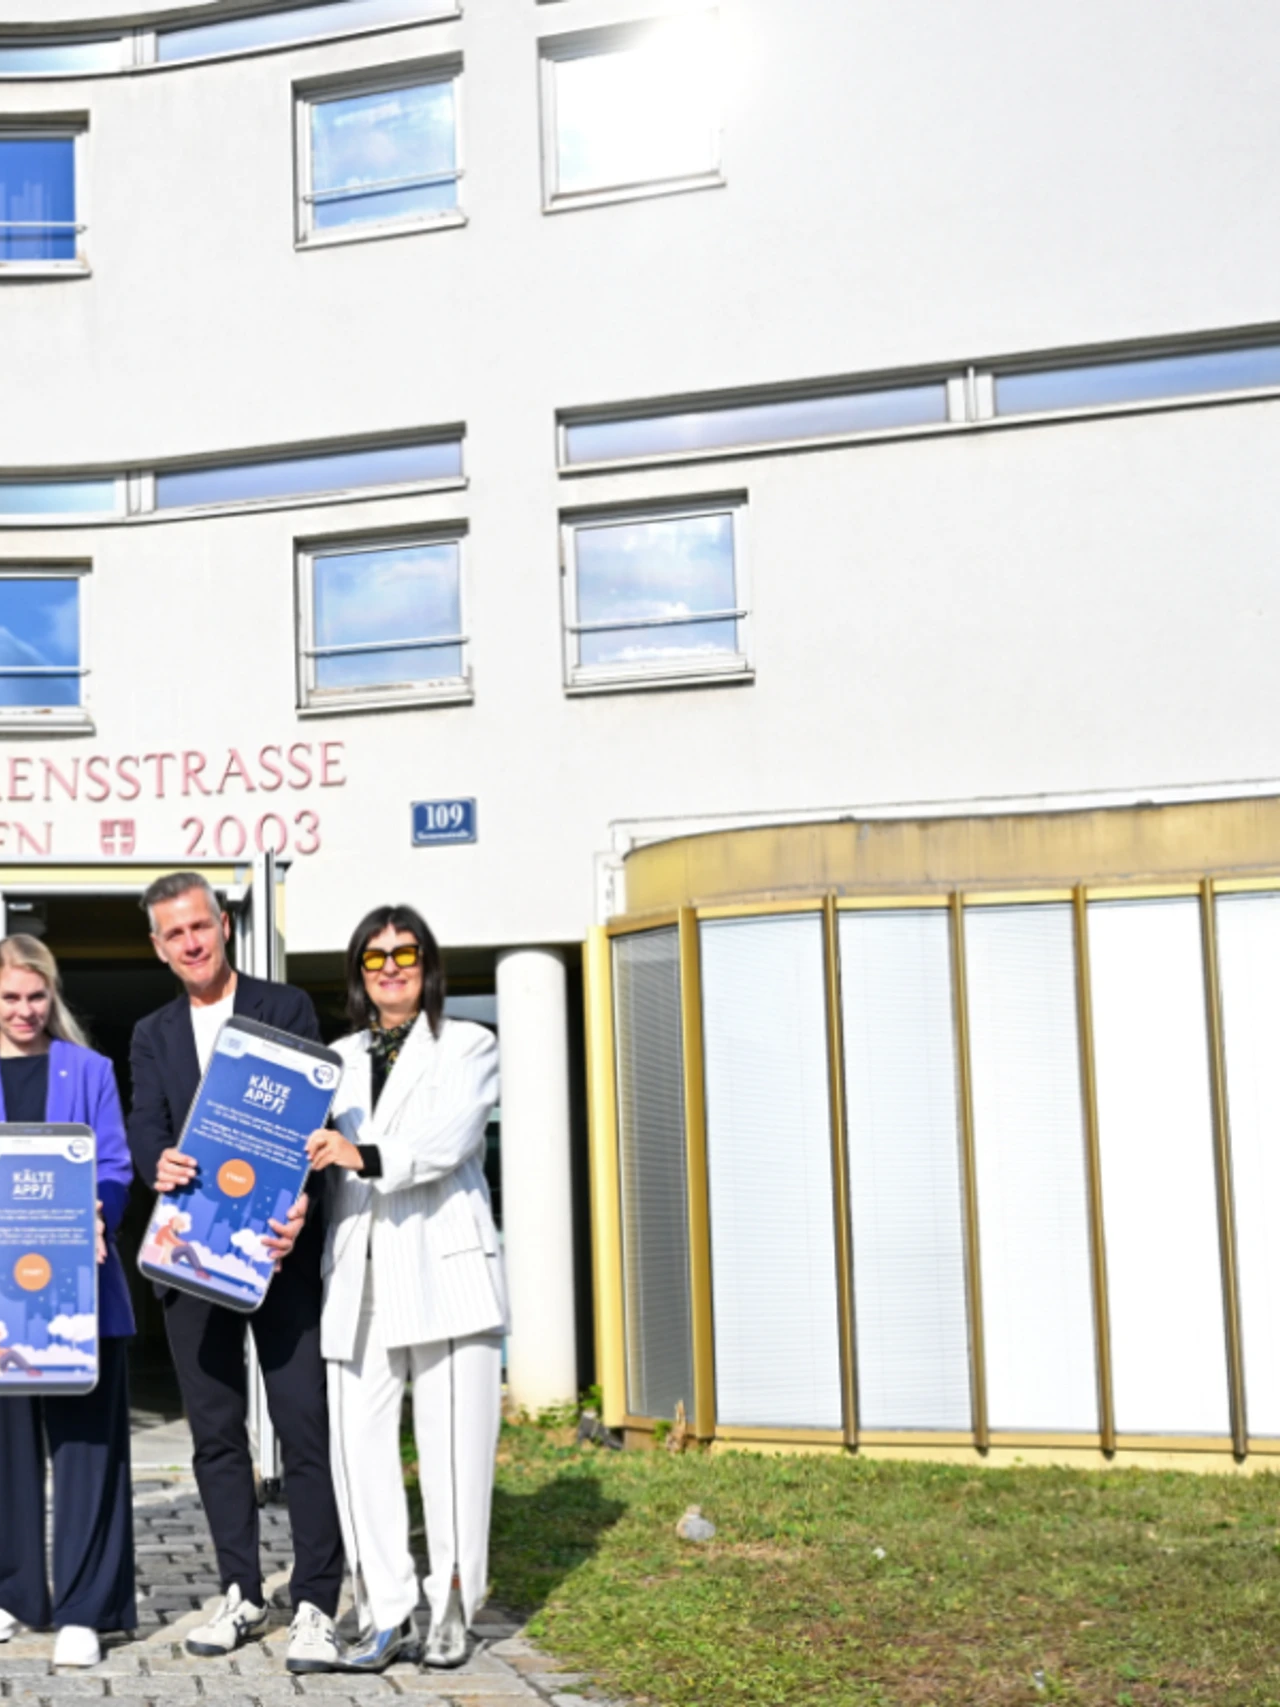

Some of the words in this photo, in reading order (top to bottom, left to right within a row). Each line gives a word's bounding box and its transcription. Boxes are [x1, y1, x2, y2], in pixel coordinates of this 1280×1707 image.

[425, 802, 464, 830] 109
[181, 809, 320, 857] 2003
[243, 1088, 273, 1105] APP
[249, 1074, 291, 1100] KÄLTE
[12, 1168, 54, 1183] KÄLTE
